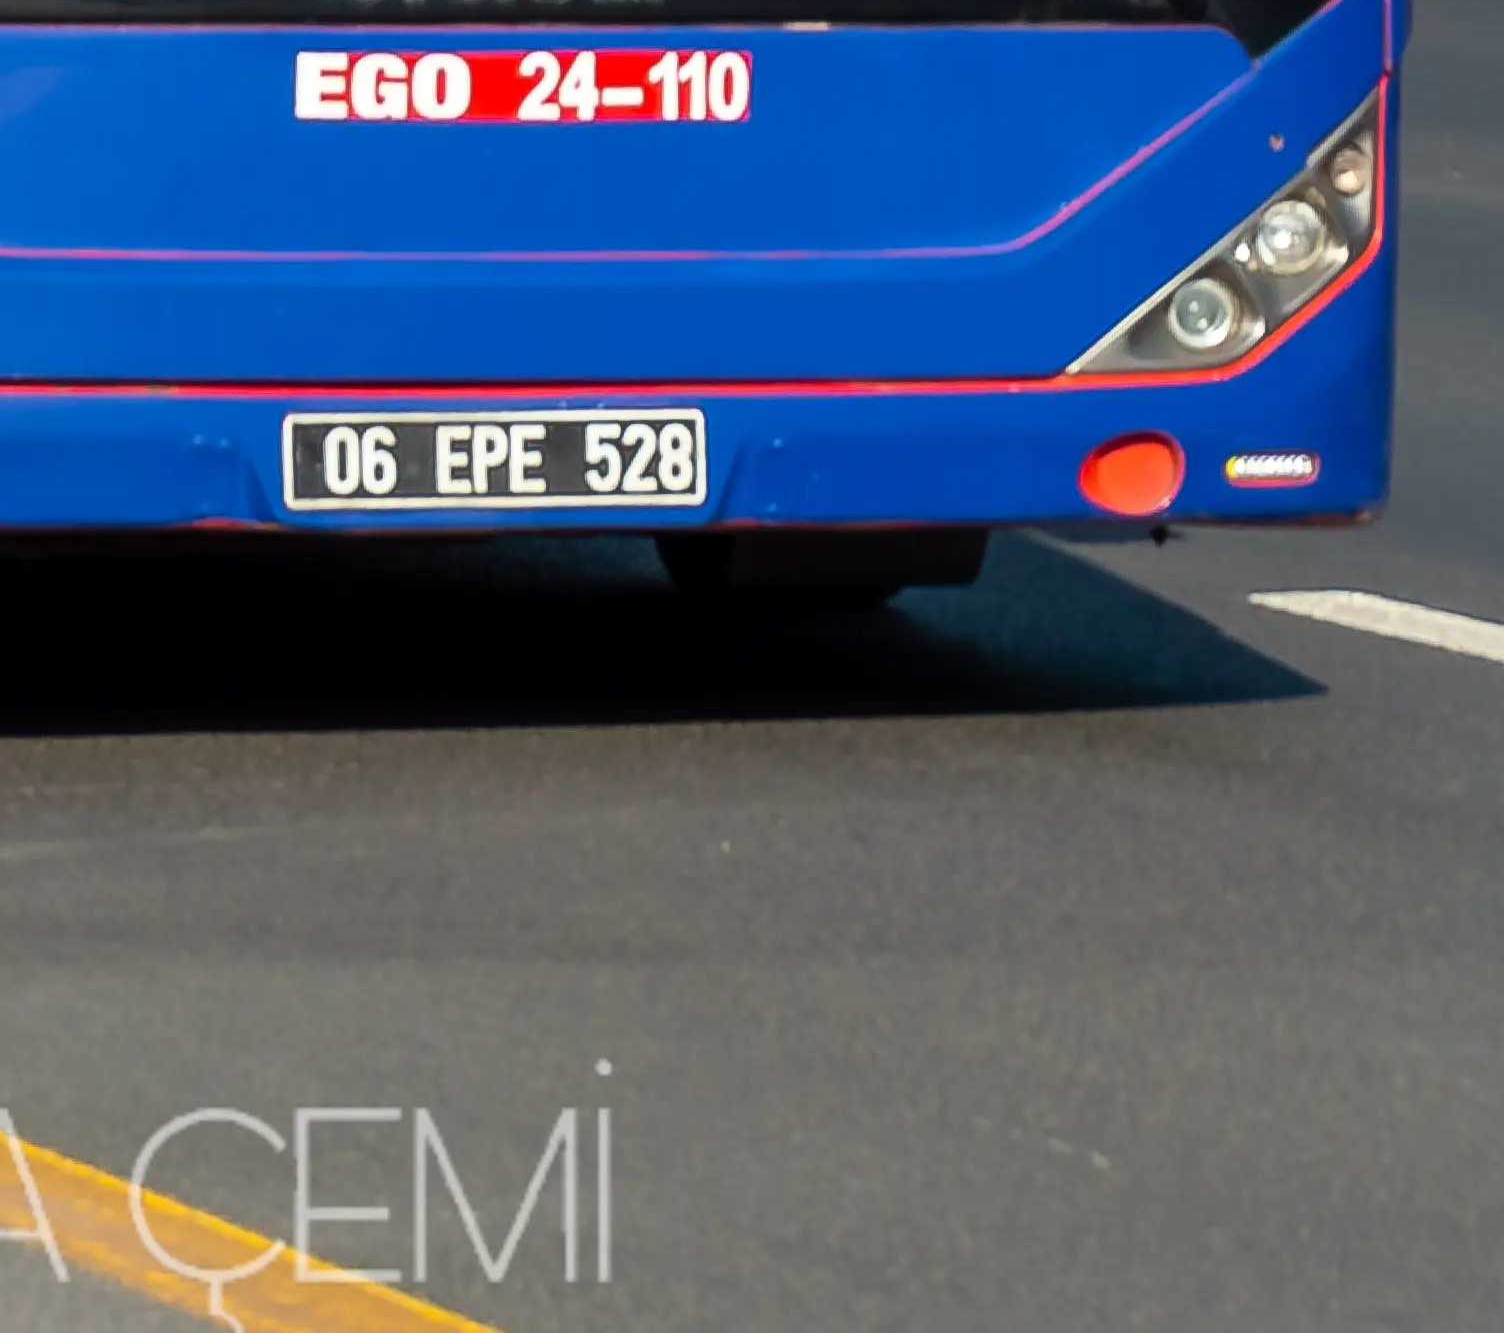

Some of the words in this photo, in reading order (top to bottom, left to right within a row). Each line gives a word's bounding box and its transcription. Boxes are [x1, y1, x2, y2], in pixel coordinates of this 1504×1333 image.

[295, 51, 472, 120] EGO
[517, 50, 750, 122] 24-110
[323, 425, 397, 495] 06
[435, 424, 547, 494] EPE
[583, 422, 695, 493] 528
